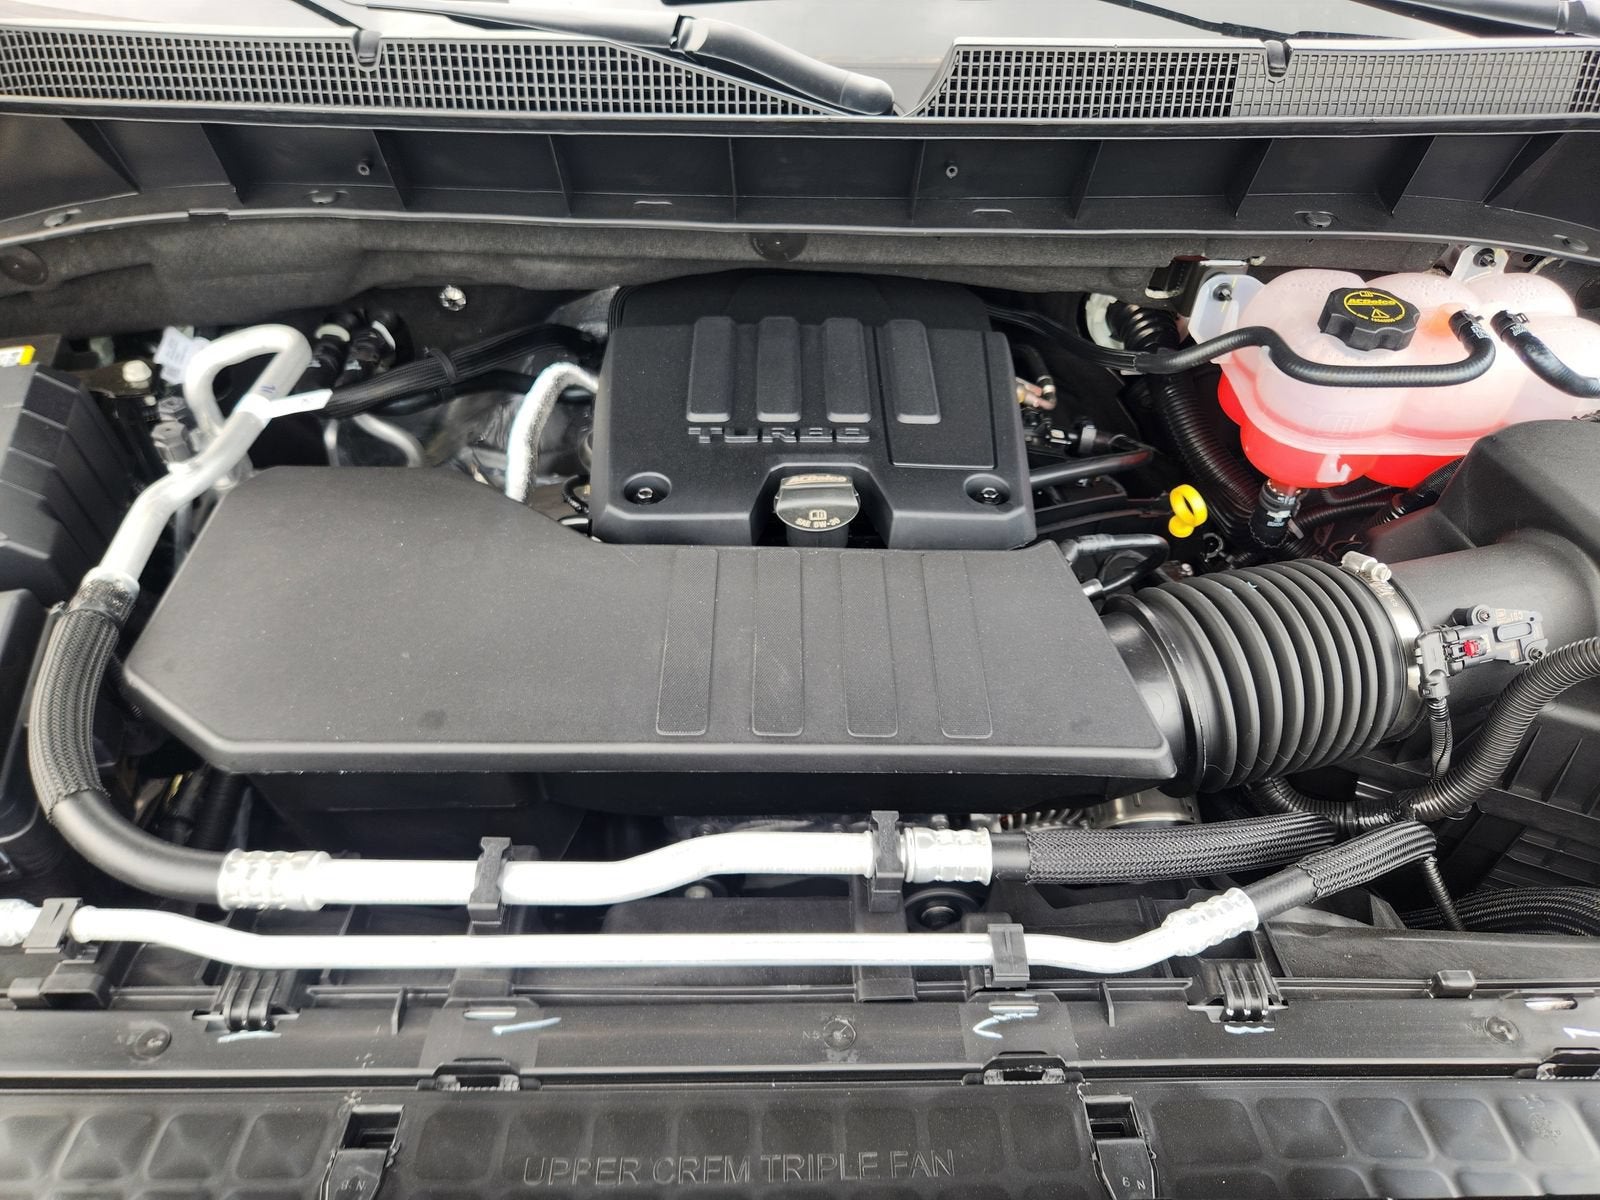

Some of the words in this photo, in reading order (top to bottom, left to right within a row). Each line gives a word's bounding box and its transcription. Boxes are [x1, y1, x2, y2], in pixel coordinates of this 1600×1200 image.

[688, 427, 870, 444] TURBO
[795, 517, 812, 528] SAE
[522, 1156, 641, 1186] UPPER
[652, 1154, 750, 1185] CRFM
[759, 1151, 881, 1183] TRIPLE
[889, 1148, 955, 1179] FAN
